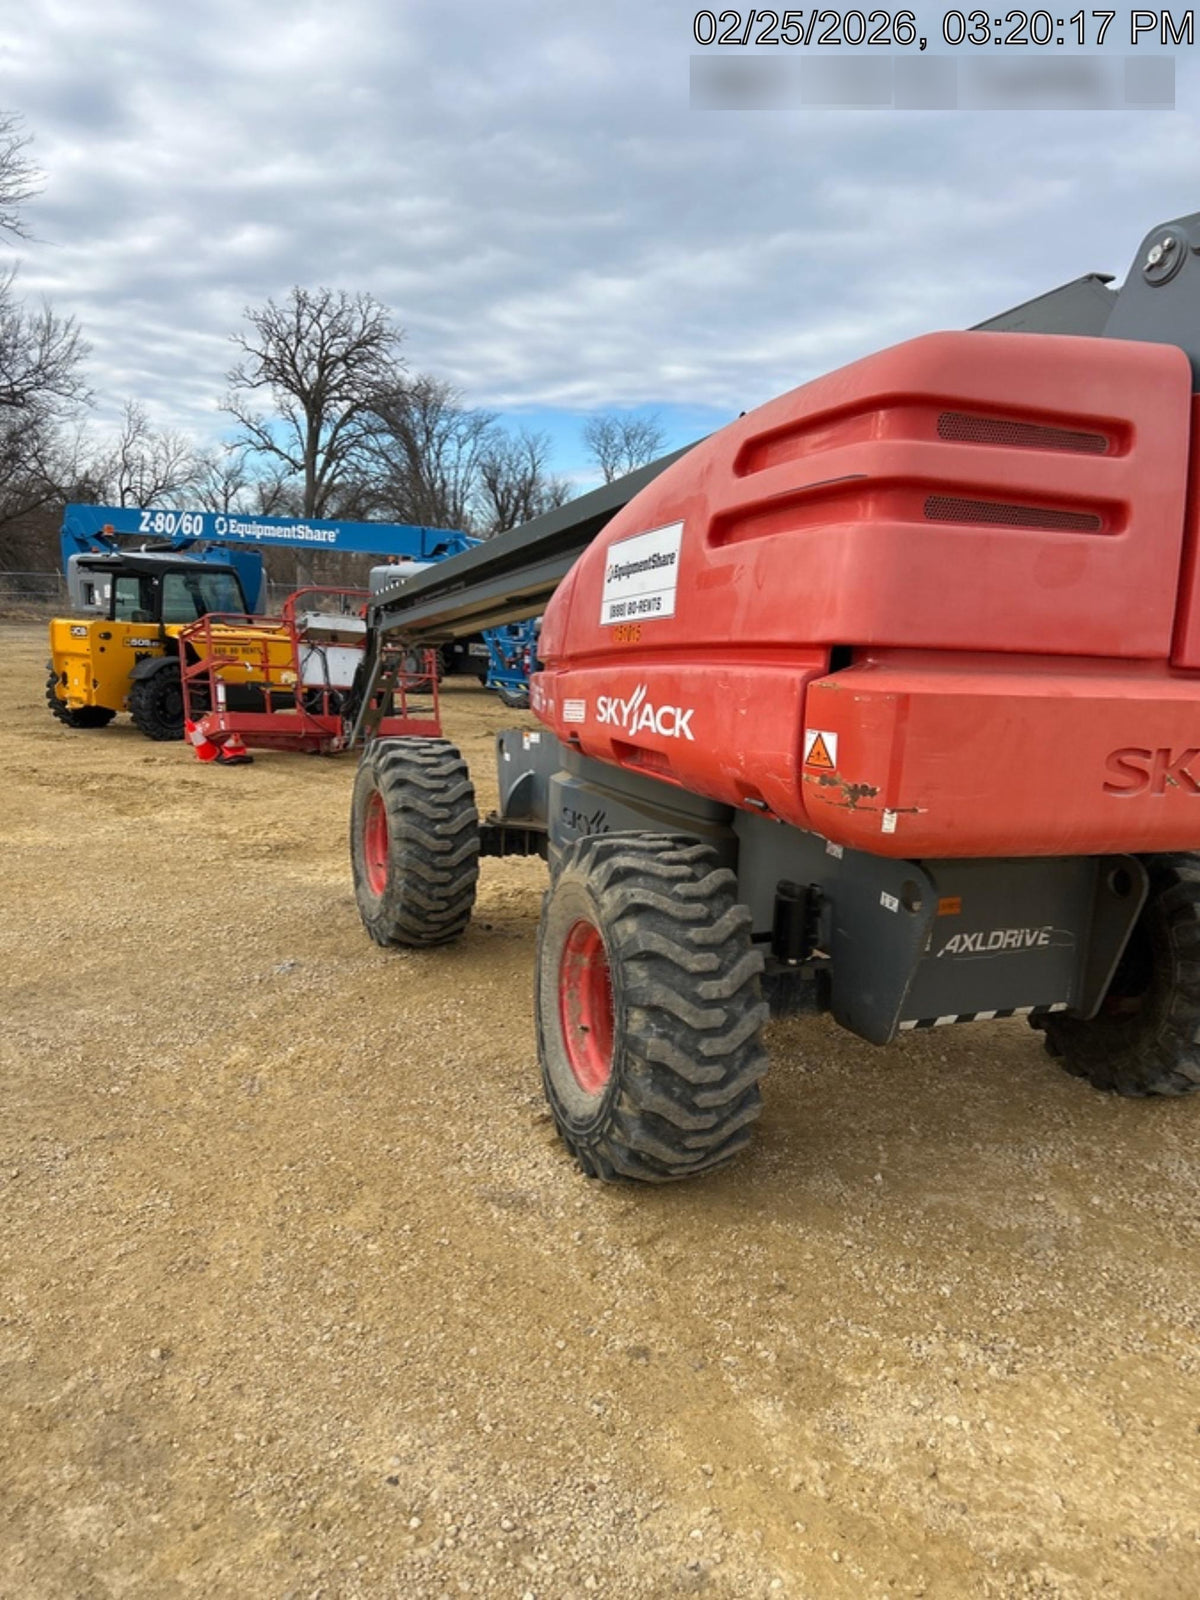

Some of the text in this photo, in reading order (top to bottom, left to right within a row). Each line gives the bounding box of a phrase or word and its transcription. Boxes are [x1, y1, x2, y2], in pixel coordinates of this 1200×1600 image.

[139, 511, 204, 537] Z-80/60
[228, 519, 337, 543] EquipmentShare
[612, 552, 676, 581] EquipmentShare
[596, 683, 695, 741] SKYJACK
